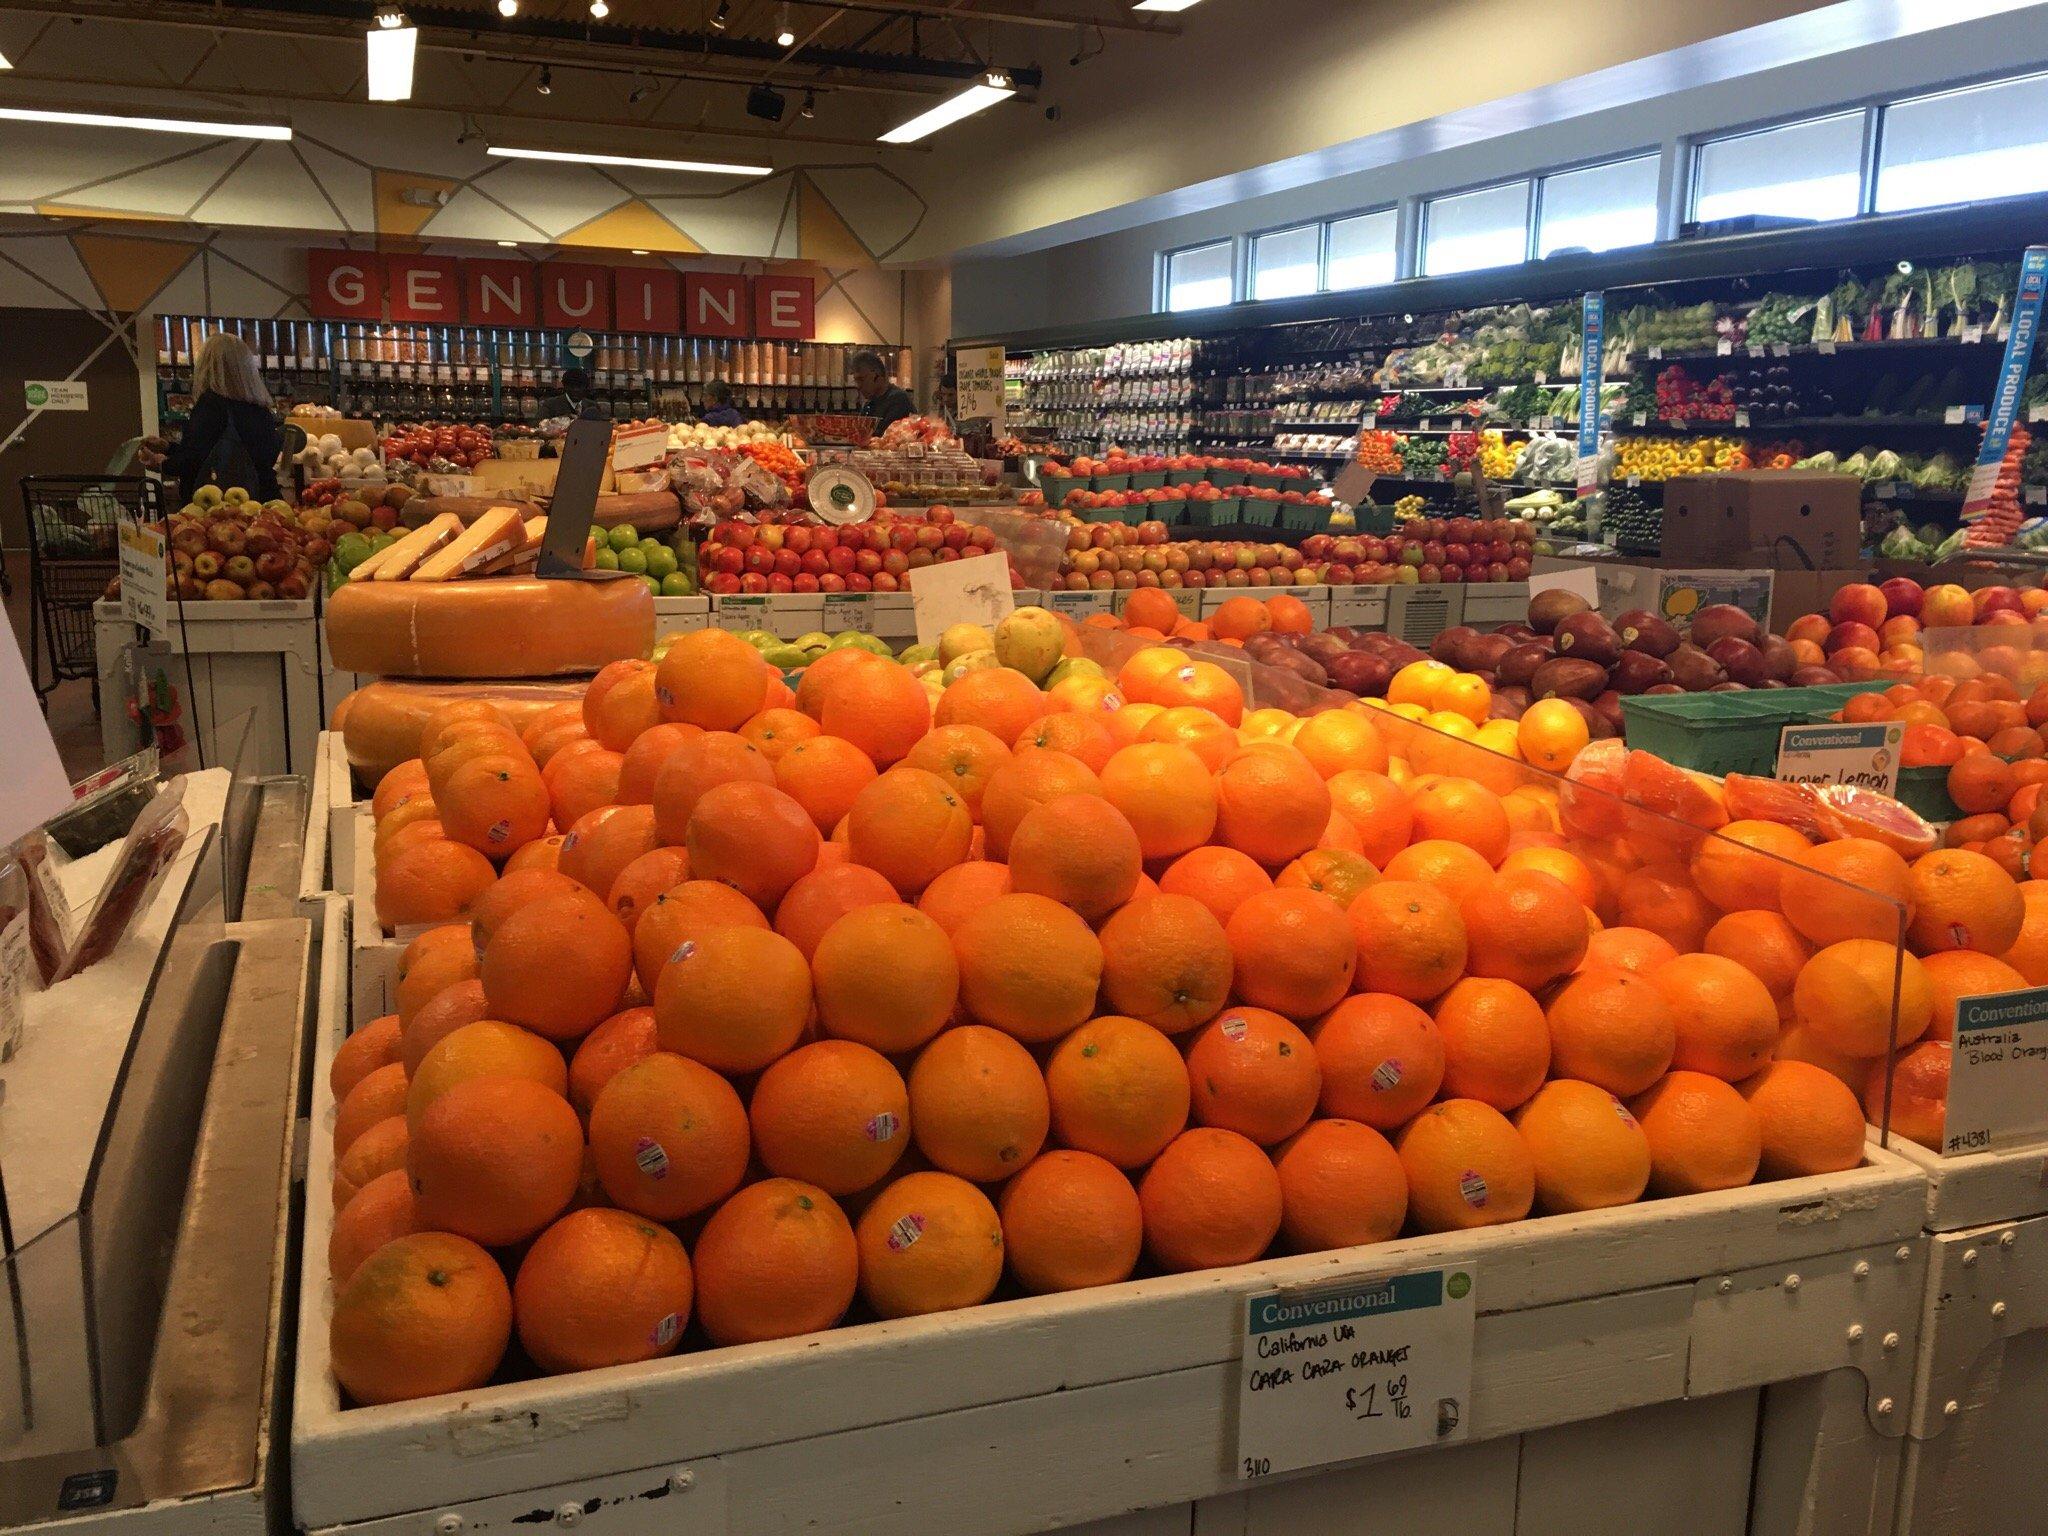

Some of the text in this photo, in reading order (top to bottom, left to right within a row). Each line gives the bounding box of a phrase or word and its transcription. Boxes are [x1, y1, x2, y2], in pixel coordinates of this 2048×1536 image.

[327, 265, 802, 328] GENUINE
[1992, 310, 2034, 436] LOCAL PRODUCE
[1583, 340, 1598, 434] LOCAL PRODUCE
[1791, 732, 1862, 747] Conventional
[1959, 1031, 2022, 1049] Australia
[1966, 1050, 2004, 1065] Blood
[1949, 1129, 1991, 1151] #4381
[1262, 1285, 1396, 1325] Conventional
[1258, 1333, 1327, 1359] California
[1250, 1345, 1411, 1391] CARA CARA ORANGES
[1243, 1457, 1270, 1479] 3110
